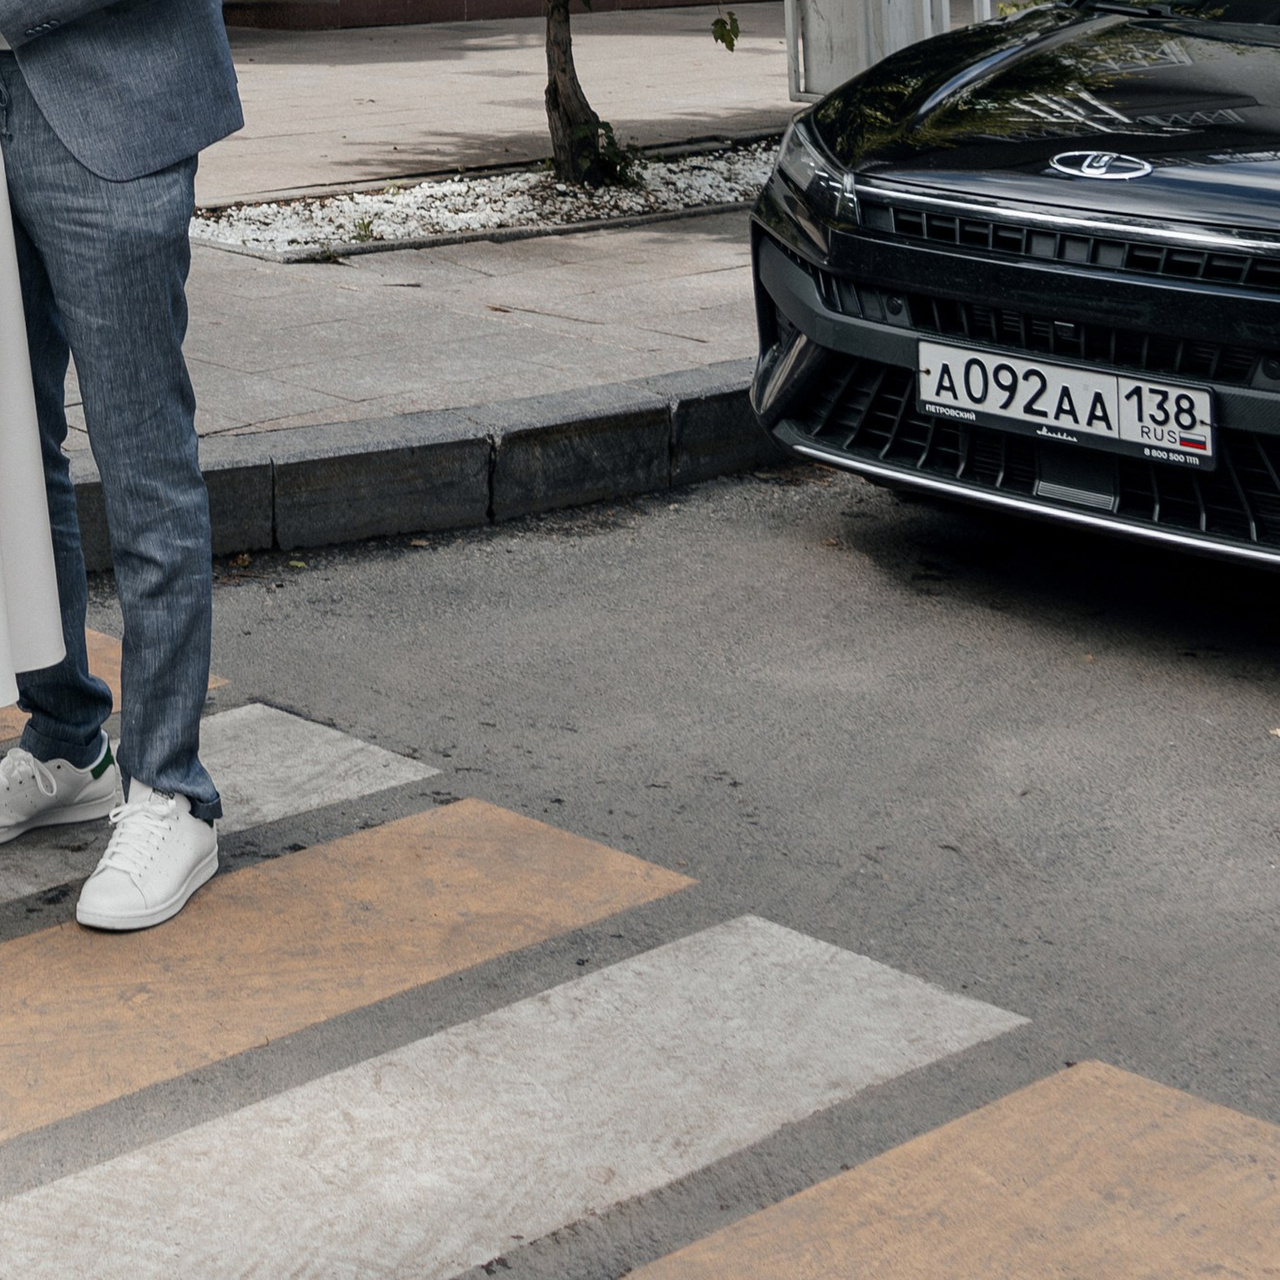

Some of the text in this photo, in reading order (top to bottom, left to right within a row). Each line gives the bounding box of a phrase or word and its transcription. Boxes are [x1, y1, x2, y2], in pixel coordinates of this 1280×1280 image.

[924, 403, 976, 422] ПЕТРОВСКИЙ
[1124, 385, 1197, 430] 138
[1141, 425, 1177, 444] RUS
[1144, 447, 1150, 456] 8
[1151, 449, 1168, 459] 800
